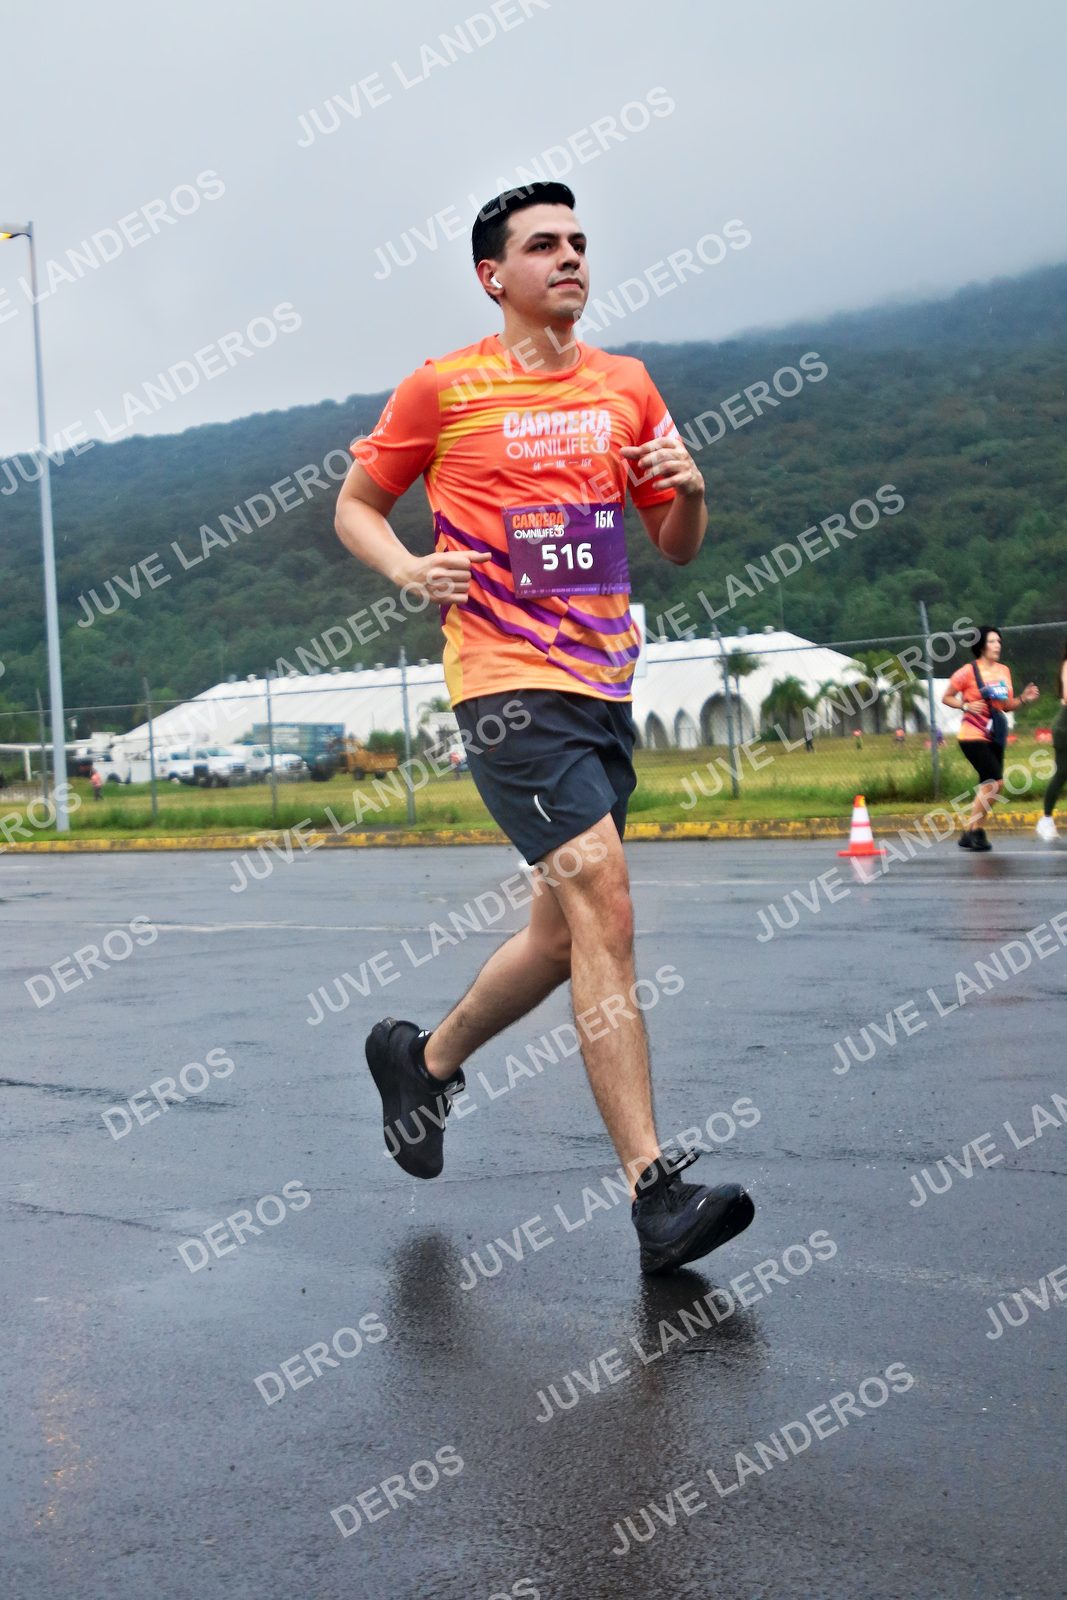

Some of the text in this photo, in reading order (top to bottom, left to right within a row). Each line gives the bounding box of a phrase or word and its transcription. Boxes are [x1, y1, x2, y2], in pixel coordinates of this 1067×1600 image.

[503, 409, 611, 438] CARRERA
[512, 511, 564, 529] CARRERA
[594, 510, 615, 529] 15K
[541, 543, 594, 570] 516
